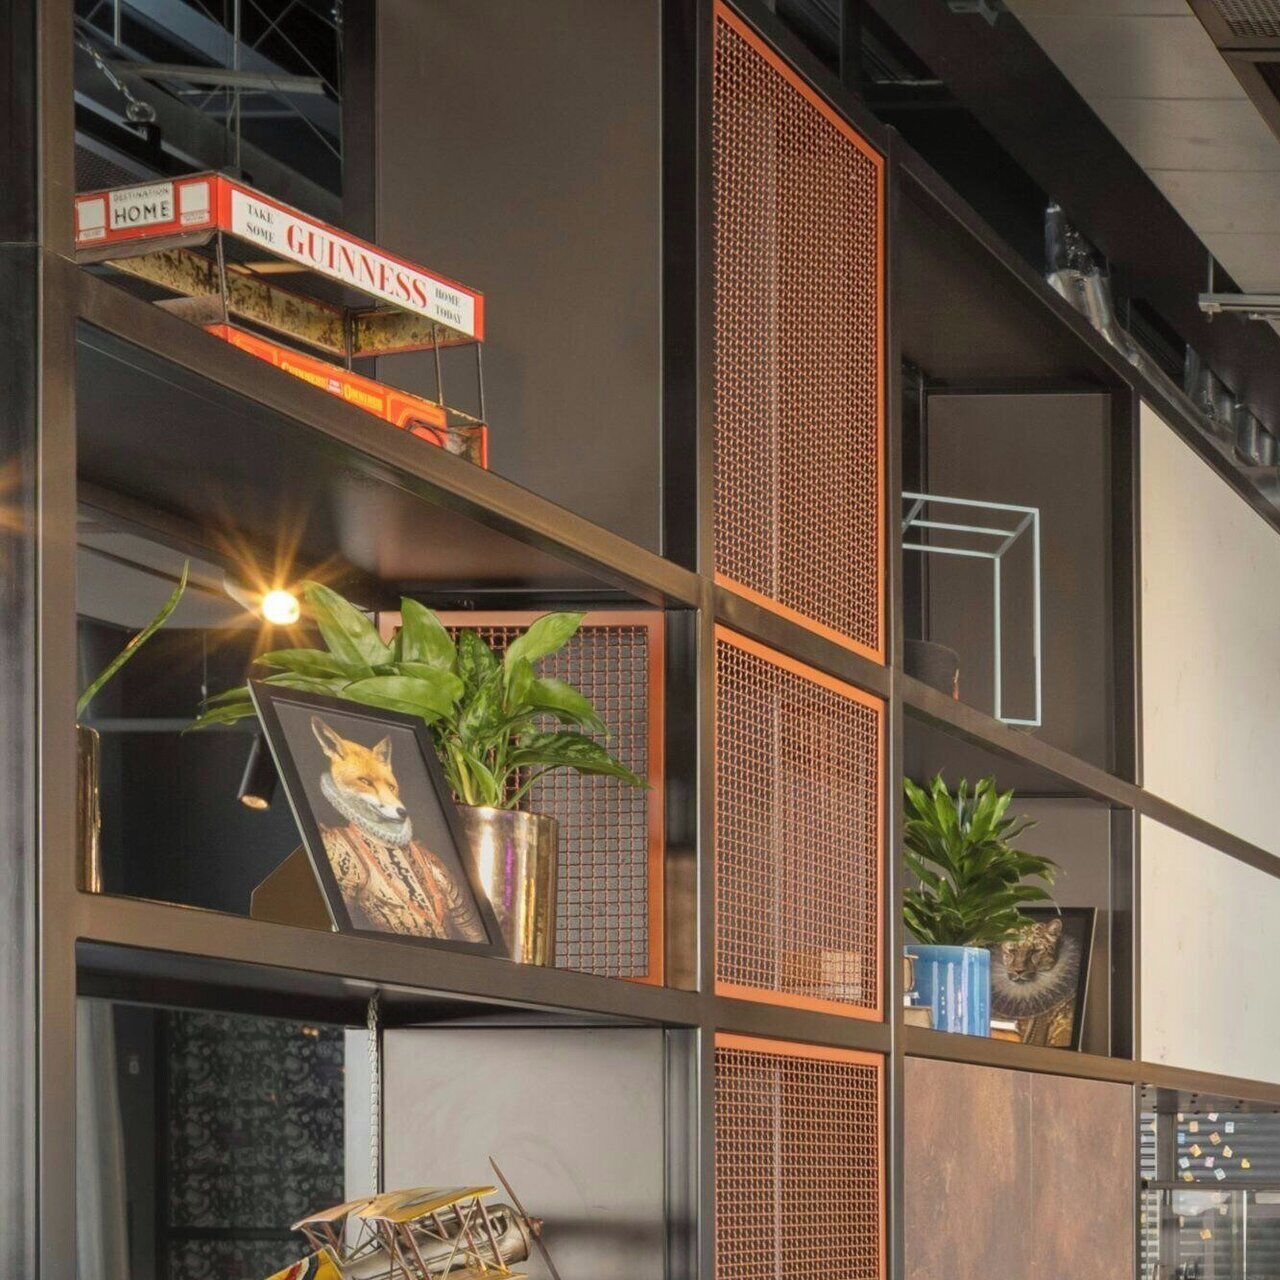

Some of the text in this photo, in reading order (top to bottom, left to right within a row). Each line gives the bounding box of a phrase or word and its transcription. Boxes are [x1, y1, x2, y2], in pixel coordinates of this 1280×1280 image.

[115, 200, 169, 225] HOME
[247, 204, 273, 225] TAKE
[246, 223, 275, 244] SOME
[286, 223, 428, 309] GUINNESS
[435, 287, 461, 306] HOME
[435, 306, 463, 325] TODAY
